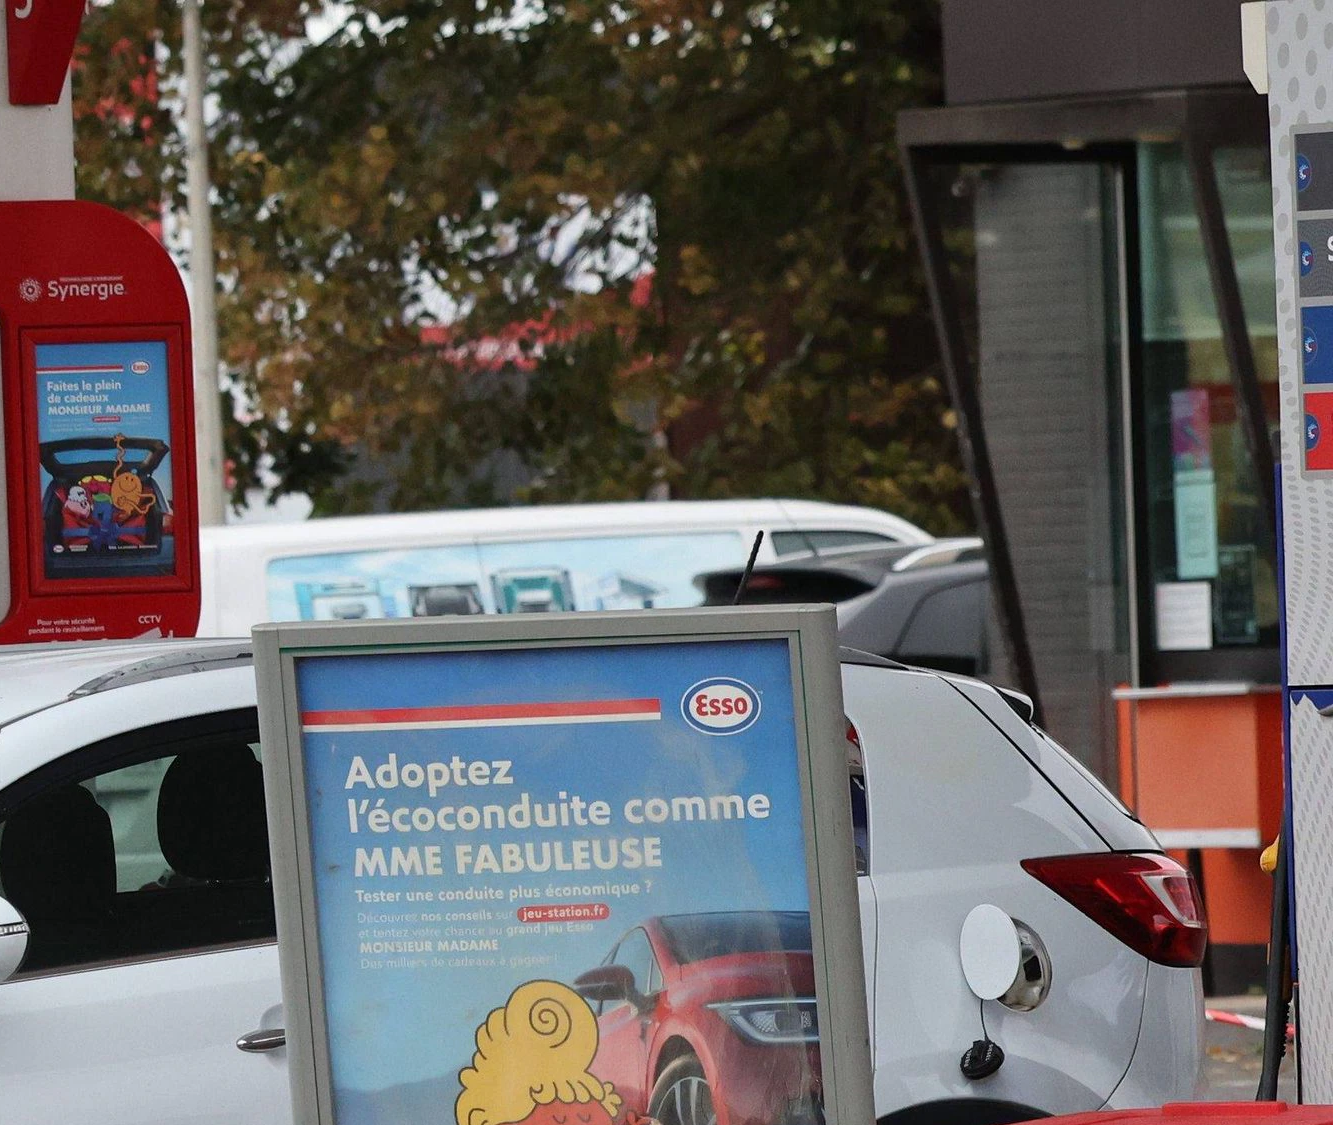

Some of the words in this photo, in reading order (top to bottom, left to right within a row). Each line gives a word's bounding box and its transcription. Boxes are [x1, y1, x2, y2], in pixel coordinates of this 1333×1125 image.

[47, 281, 125, 302] Synergie
[46, 380, 79, 391] Faites
[82, 380, 93, 390] le
[94, 380, 122, 392] plein
[47, 393, 62, 404] de
[64, 393, 109, 404] cadeaux
[48, 405, 102, 416] MONSIEUR
[106, 403, 151, 414] MADAME
[138, 615, 162, 624] CCTV
[695, 693, 748, 717] Esso
[344, 753, 514, 798] Adoptez
[347, 791, 611, 834] l'écoconduite
[624, 792, 771, 825] comme
[354, 845, 443, 877] MME
[456, 836, 663, 875] FABULEUSE
[355, 889, 401, 903] Tester
[406, 890, 434, 902] une
[438, 886, 505, 901] conduite
[509, 884, 541, 902] plus
[545, 882, 640, 898] économique
[645, 880, 653, 893] ?
[421, 913, 442, 922] nos
[445, 909, 492, 922] conseils
[495, 911, 513, 920] sur
[522, 904, 605, 923] jeu-station.fr
[506, 922, 541, 937] grand
[544, 922, 563, 937] jeu
[360, 940, 433, 953] MONSIEUR
[437, 939, 499, 952] MADAME
